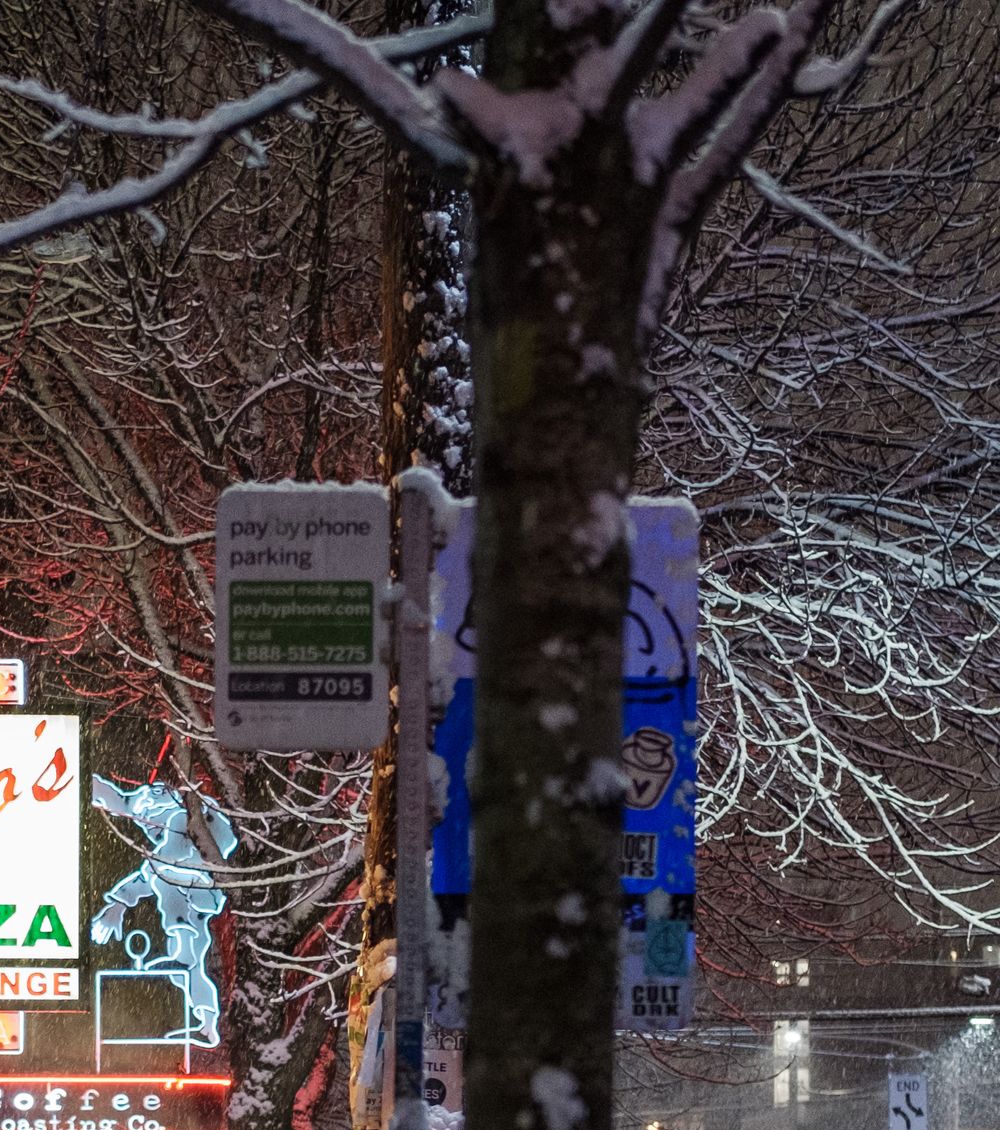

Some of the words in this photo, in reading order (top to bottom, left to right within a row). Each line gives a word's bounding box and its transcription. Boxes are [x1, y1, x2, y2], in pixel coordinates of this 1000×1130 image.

[230, 520, 268, 541] pay
[275, 517, 300, 541] by
[305, 517, 371, 541] phone
[230, 547, 313, 571] parking
[232, 601, 371, 618] paybyphone.com
[232, 646, 367, 662] 1-888-515-7275
[297, 677, 365, 696] 87095
[632, 985, 680, 1004] CULT
[896, 1080, 921, 1093] END
